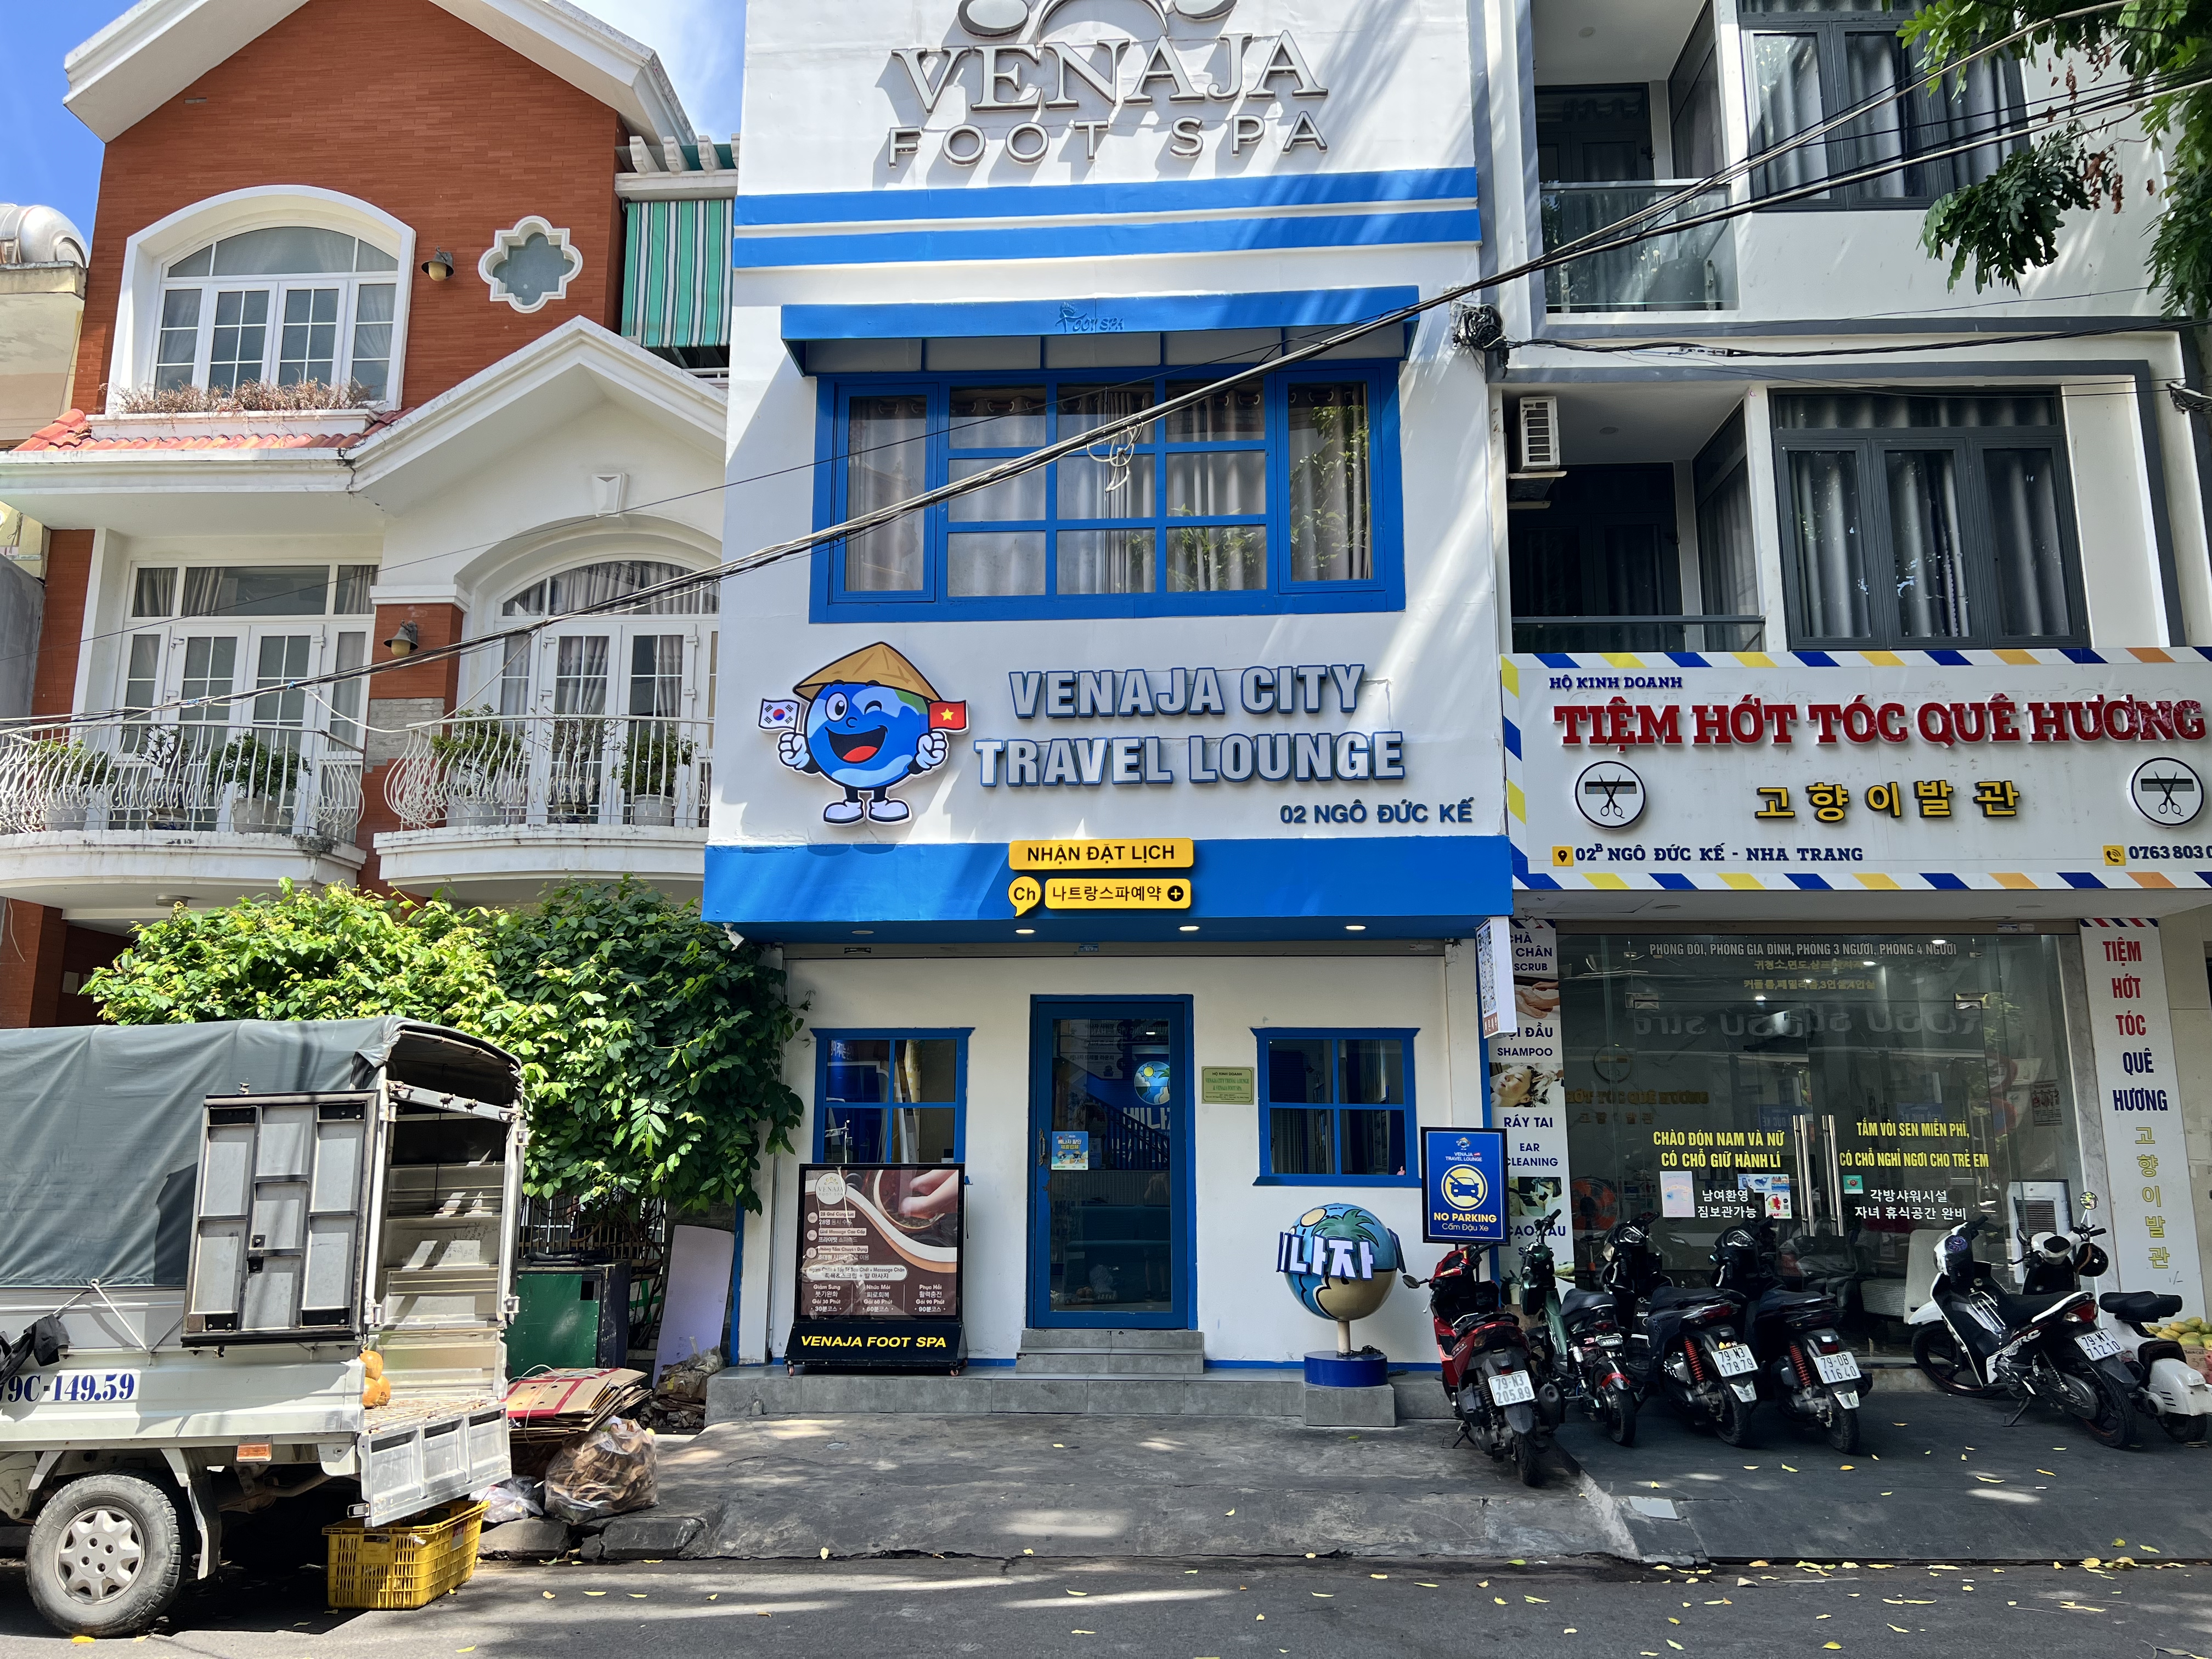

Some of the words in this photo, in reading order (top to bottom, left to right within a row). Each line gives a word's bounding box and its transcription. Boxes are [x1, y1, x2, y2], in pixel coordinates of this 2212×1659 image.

[891, 30, 1329, 114] VENAJA
[888, 119, 1109, 168] FOOT
[1170, 111, 1328, 159] SPA
[1008, 667, 1226, 719] VENAJA
[1240, 663, 1365, 714] CITY
[1549, 674, 1573, 692] HỘ
[1576, 676, 1620, 690] KINH
[1623, 676, 1683, 689] DOANH
[1553, 696, 1683, 754] TIỆM
[1690, 693, 1797, 747] HỚT
[1805, 693, 1909, 746] TÓC
[1914, 692, 2021, 749] QUÊ
[2024, 693, 2207, 744] HƯƠNG
[974, 735, 1173, 787] TRAVEL
[1188, 731, 1406, 783] LOUNGE
[1280, 804, 1307, 824] 02
[1314, 799, 1367, 824] NGÔ
[1376, 798, 1429, 823] ĐỨC
[1440, 797, 1475, 823] KẾ
[1754, 780, 2020, 823] 고향이발관
[1027, 844, 1081, 865] NHẬN
[1086, 843, 1126, 865] ĐẶT
[1132, 845, 1175, 864] LỊCH
[1607, 844, 1646, 862] NGÔ
[1654, 844, 1691, 862] ĐỨC
[1699, 842, 1725, 862] KẾ
[1746, 847, 1788, 862] NHA
[1797, 847, 1864, 861] TRANG
[2129, 845, 2171, 859] 0763
[2172, 845, 2204, 859] 803
[1013, 887, 1036, 901] Ch
[1052, 885, 1162, 902] 나트랑스파예약
[1515, 945, 1553, 958] CHÂN
[1649, 941, 1684, 956] PHÒNG
[1686, 941, 1708, 957] ĐÔI,
[1709, 941, 1745, 955] PHÒNG
[1746, 944, 1764, 955] GIA
[1766, 940, 1795, 957] ĐÌNH,
[1796, 940, 1831, 956] PHÒNG
[1833, 943, 1840, 955] 3
[1842, 940, 1877, 957] NGƯỜI,
[1879, 940, 1915, 956] PHÒNG
[1916, 943, 1923, 955] 4
[2102, 936, 2142, 967] TIỆM
[1514, 963, 1548, 972] SCRUB
[2112, 973, 2141, 998] HỚT
[1525, 1022, 1554, 1038] ĐẦU
[2115, 1010, 2147, 1036] TÓC
[1497, 1047, 1553, 1057] SHAMPOO
[2122, 1047, 2154, 1076] QUÊ
[2112, 1087, 2168, 1111] HƯƠNG
[1504, 1114, 1530, 1128] RÁY
[1534, 1117, 1553, 1128] TAI
[1857, 1117, 1878, 1137] TẮM
[1880, 1119, 1897, 1137] VÒI
[1899, 1122, 1918, 1137] SEN
[1921, 1117, 1948, 1137] MIỄN
[1950, 1120, 1970, 1138] PHÍ,
[1653, 1129, 1685, 1146] CHÀO
[1688, 1129, 1713, 1146] ĐÓN
[1717, 1132, 1745, 1146] NAM
[1747, 1129, 1764, 1146] VÀ
[1767, 1129, 1785, 1147] NỮ
[1519, 1143, 1541, 1152] EAR
[1661, 1149, 1678, 1167] CÓ
[1682, 1148, 1706, 1167] CHỖ
[1710, 1150, 1733, 1167] GIỮ
[1735, 1150, 1769, 1168] HÀNH
[1770, 1150, 1781, 1168] LÍ
[1839, 1149, 1853, 1167] CÓ
[1855, 1147, 1875, 1167] CHỖ
[1877, 1148, 1901, 1167] NGHỈ
[1903, 1151, 1928, 1167] NGƠI
[1929, 1152, 1950, 1167] CHO
[1951, 1148, 1971, 1167] TRẺ
[1973, 1153, 1990, 1167] EM
[1701, 1189, 1749, 1203] 남여환영
[1869, 1189, 1948, 1204] 각방샤워시설
[2134, 1127, 2170, 1269] 고향이발관
[1433, 1212, 1449, 1221] NO
[1451, 1212, 1498, 1223] PARKING
[1697, 1205, 1757, 1220] 짐보관가능
[1854, 1205, 1880, 1220] 자녀
[1884, 1206, 1937, 1220] 휴식공간
[1940, 1207, 1967, 1221] 완비
[1441, 1221, 1460, 1231] Cấm
[1462, 1223, 1478, 1233] Đậu
[1479, 1224, 1490, 1232] Xe
[801, 1336, 863, 1347] VENAJA
[867, 1336, 911, 1347] FOOT
[916, 1337, 947, 1347] SPA
[2081, 1331, 2109, 1347] 79-N1
[1, 1373, 135, 1403] 9C-149.59
[1495, 1375, 1525, 1391] 79-N3
[1496, 1386, 1532, 1404] 205.89
